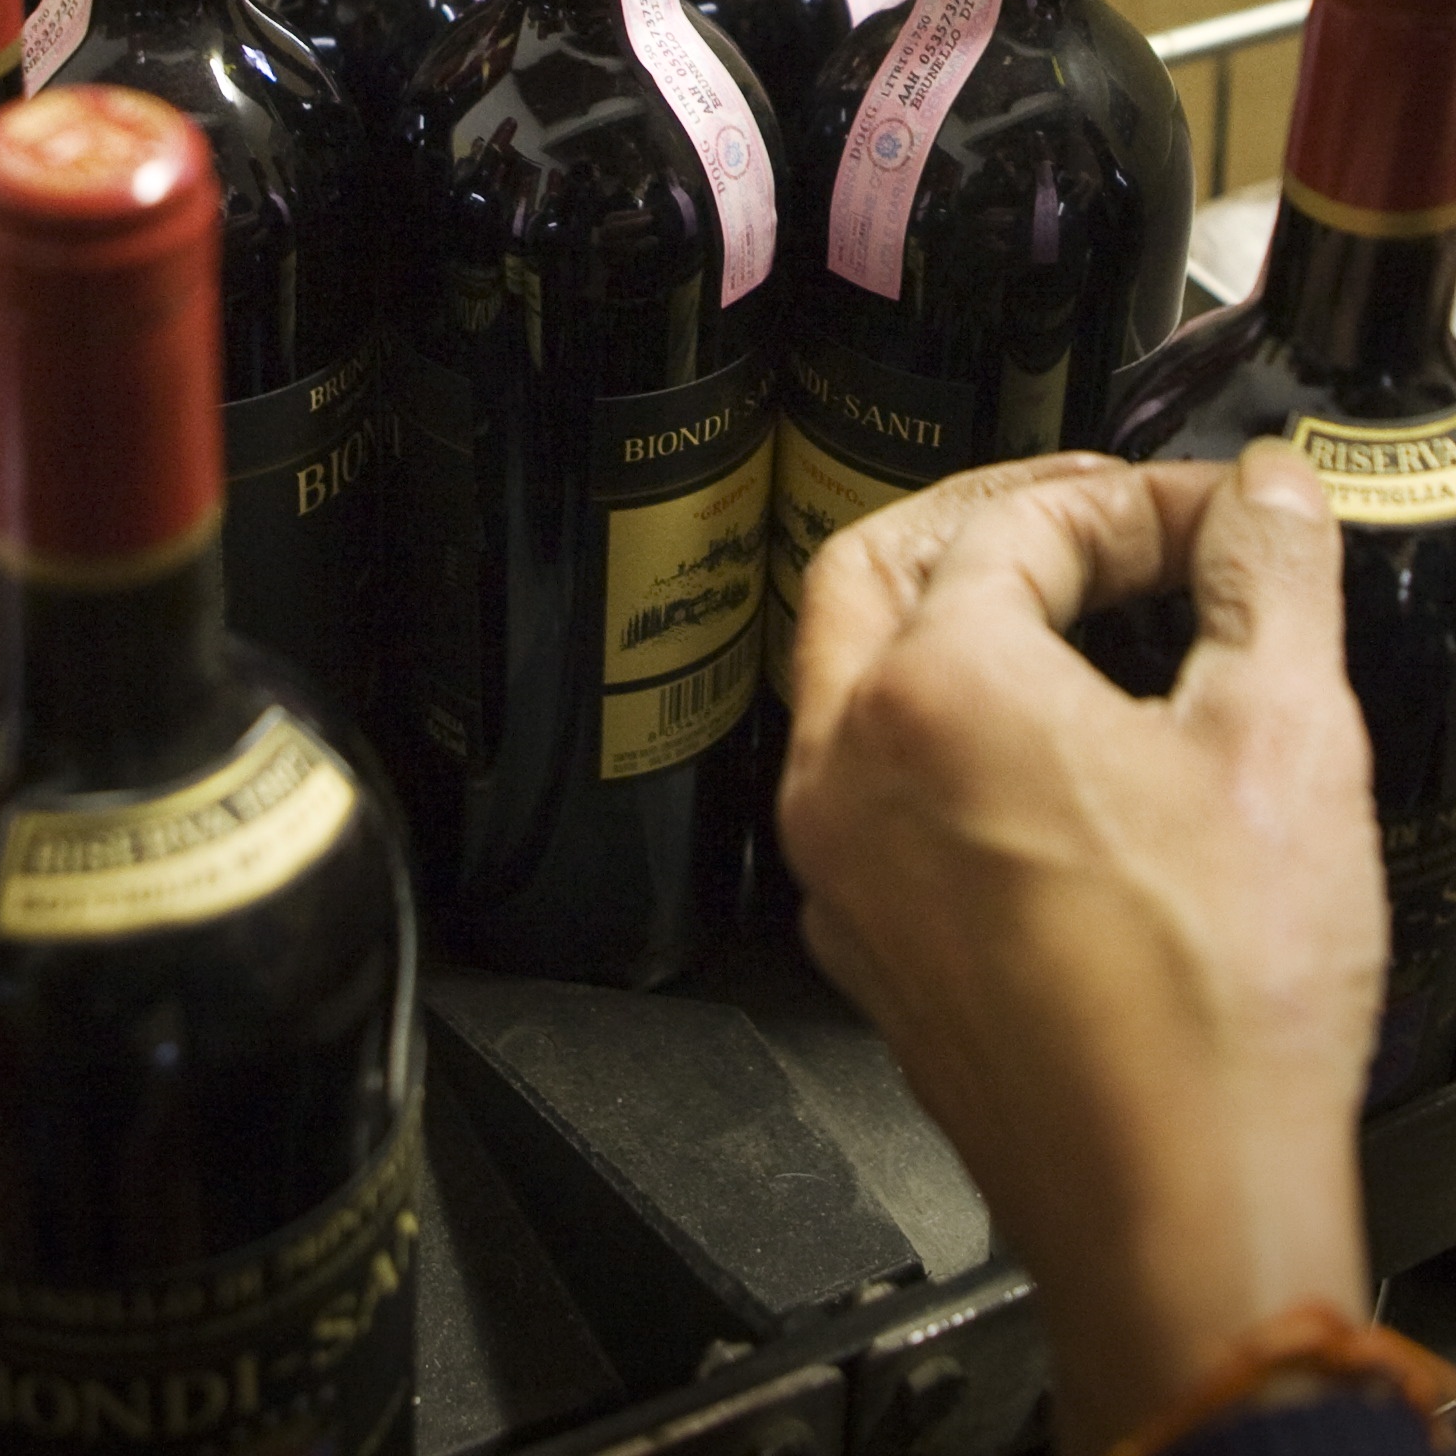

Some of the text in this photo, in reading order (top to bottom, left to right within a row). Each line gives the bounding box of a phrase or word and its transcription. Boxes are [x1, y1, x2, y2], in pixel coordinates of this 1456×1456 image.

[651, 0, 666, 21] DI
[665, 31, 722, 111] BRUNELLO
[881, 52, 909, 98] LITRI
[897, 73, 921, 106] AAH
[911, 27, 962, 112] BRUNELLO
[688, 80, 714, 115] AAH
[849, 106, 878, 161] DOCG
[1321, 480, 1456, 505] OTTIGLIA
